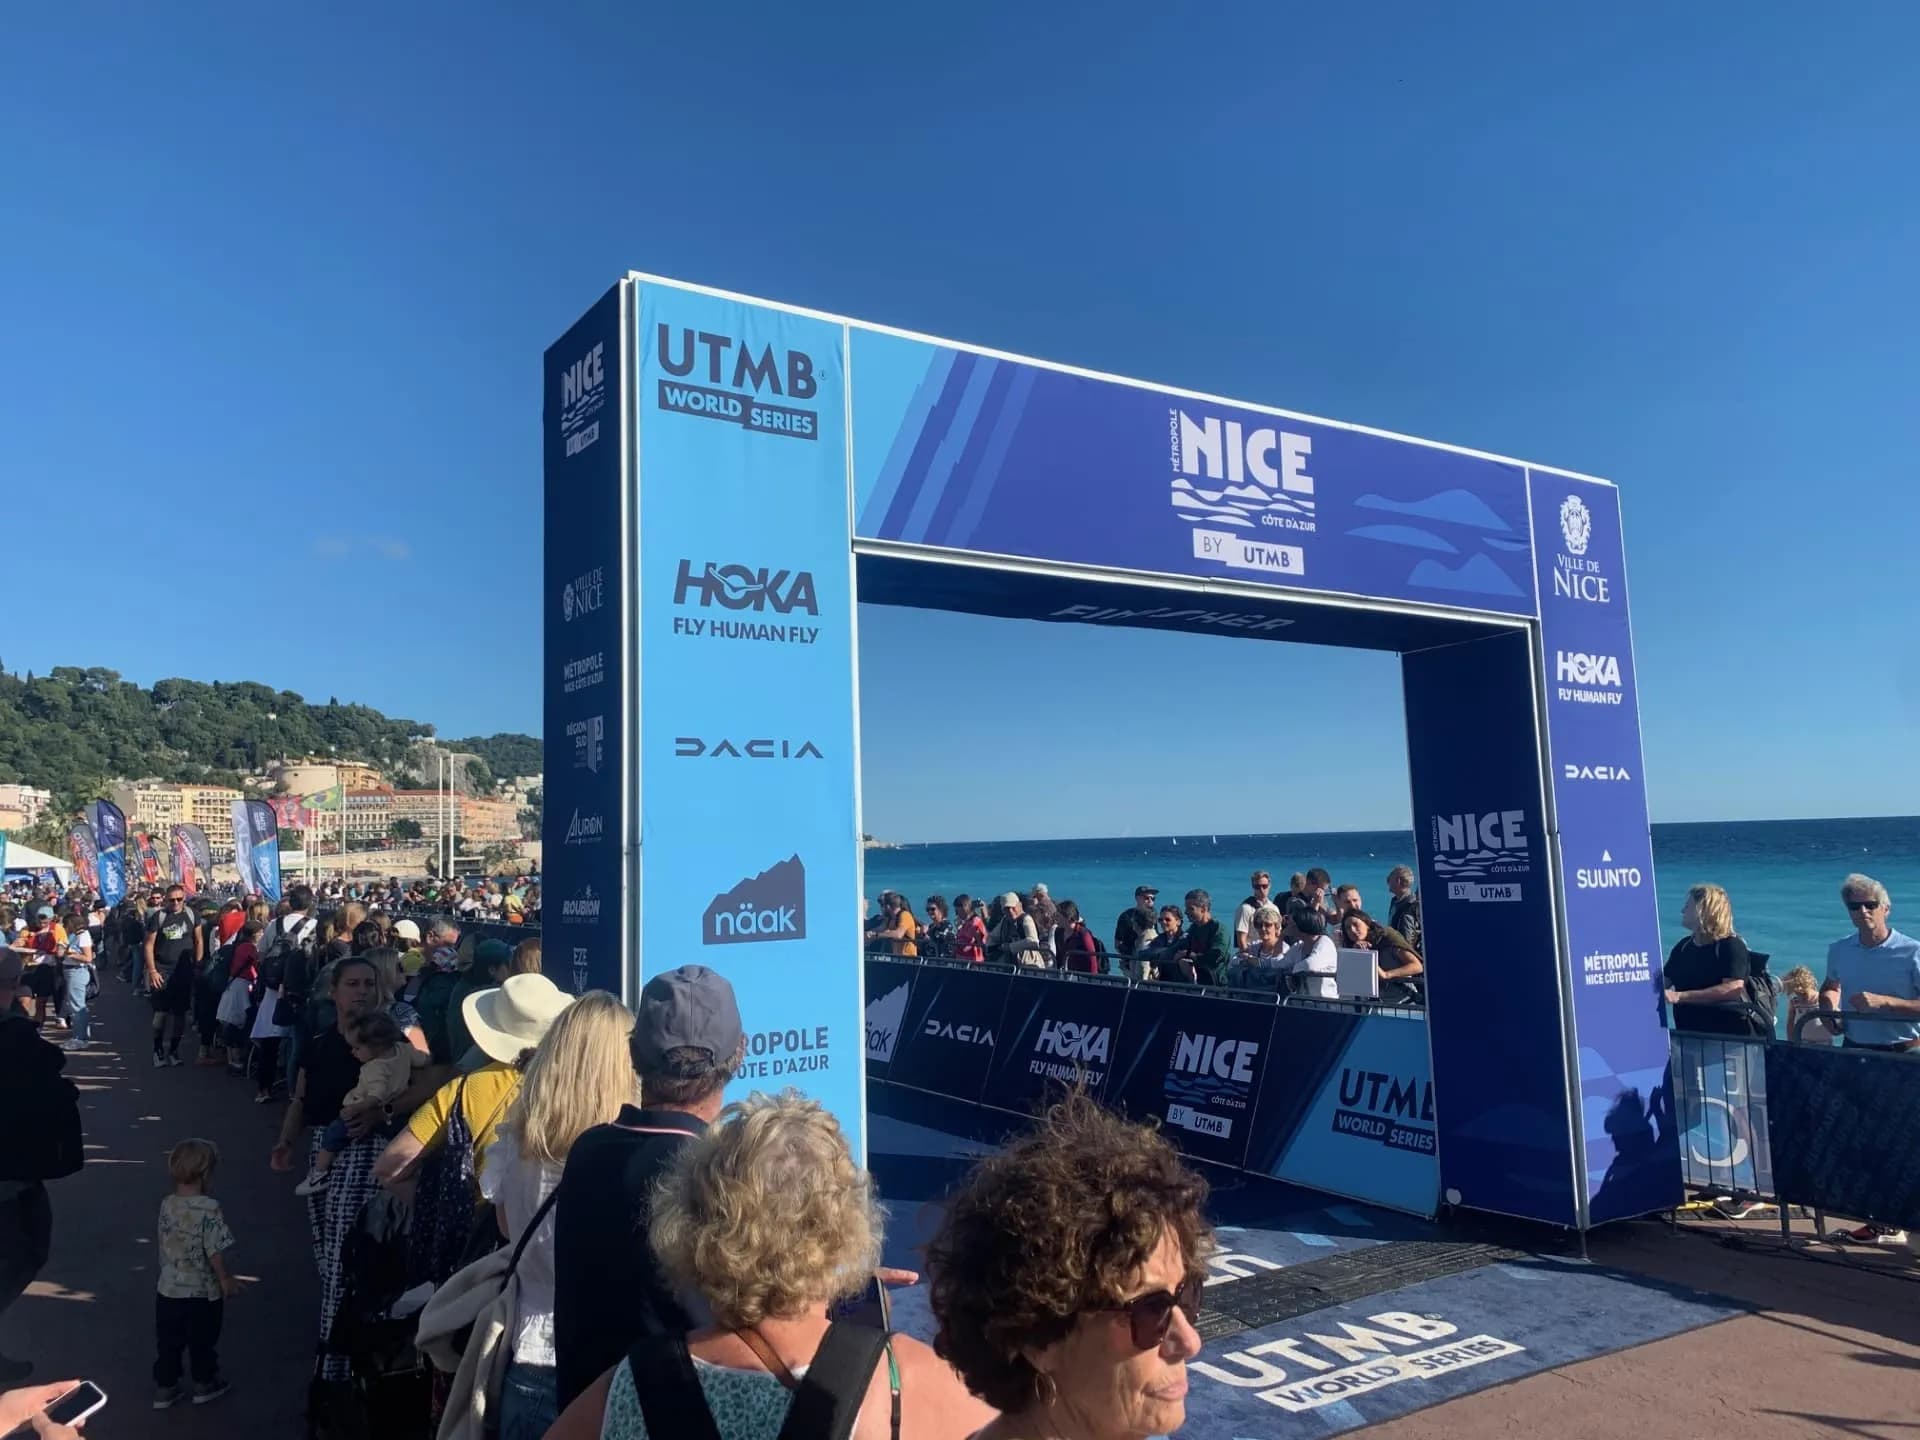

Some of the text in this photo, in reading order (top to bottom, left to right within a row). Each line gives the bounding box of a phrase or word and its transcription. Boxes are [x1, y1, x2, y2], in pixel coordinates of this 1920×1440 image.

[561, 341, 604, 408] NICE
[657, 323, 818, 400] UTMB
[664, 386, 813, 434] WORLD SERIES
[1169, 408, 1181, 472] MÉTROPOLE
[1180, 409, 1315, 495] NICE
[1261, 515, 1316, 533] CÔTE D'AZUR
[1203, 536, 1290, 567] BY UTMB
[1557, 553, 1601, 573] VILLE DE
[592, 566, 604, 584] DE
[673, 559, 819, 616] HOKA
[1553, 566, 1611, 603] NICE
[575, 583, 604, 617] NICE
[673, 617, 819, 644] FLY HUMAN FLY
[1556, 650, 1622, 687] HOKA
[1558, 688, 1622, 705] FLY HUMAN FLY
[675, 737, 825, 759] DACIA
[1565, 764, 1631, 781] DACIA
[1437, 810, 1528, 851] NICE
[1454, 885, 1513, 898] BY UTMB
[1576, 868, 1641, 888] SUUNTO
[715, 902, 797, 936] näak
[1584, 950, 1649, 971] MÉTROPOLE
[1585, 973, 1604, 985] NICE
[1604, 970, 1625, 983] CÔTE
[925, 1019, 994, 1046] DACIA
[1034, 1019, 1111, 1063] HOKA
[773, 1054, 829, 1076] D'AZUR
[1029, 1060, 1047, 1074] FLY
[1084, 1070, 1104, 1086] FLY
[1174, 1031, 1259, 1083] NICE
[1172, 1108, 1223, 1133] BY UTMB
[1338, 1114, 1434, 1150] WORLD SERIES
[1187, 1311, 1459, 1388] UTMB
[1275, 1338, 1507, 1404] WORLD SERIES
